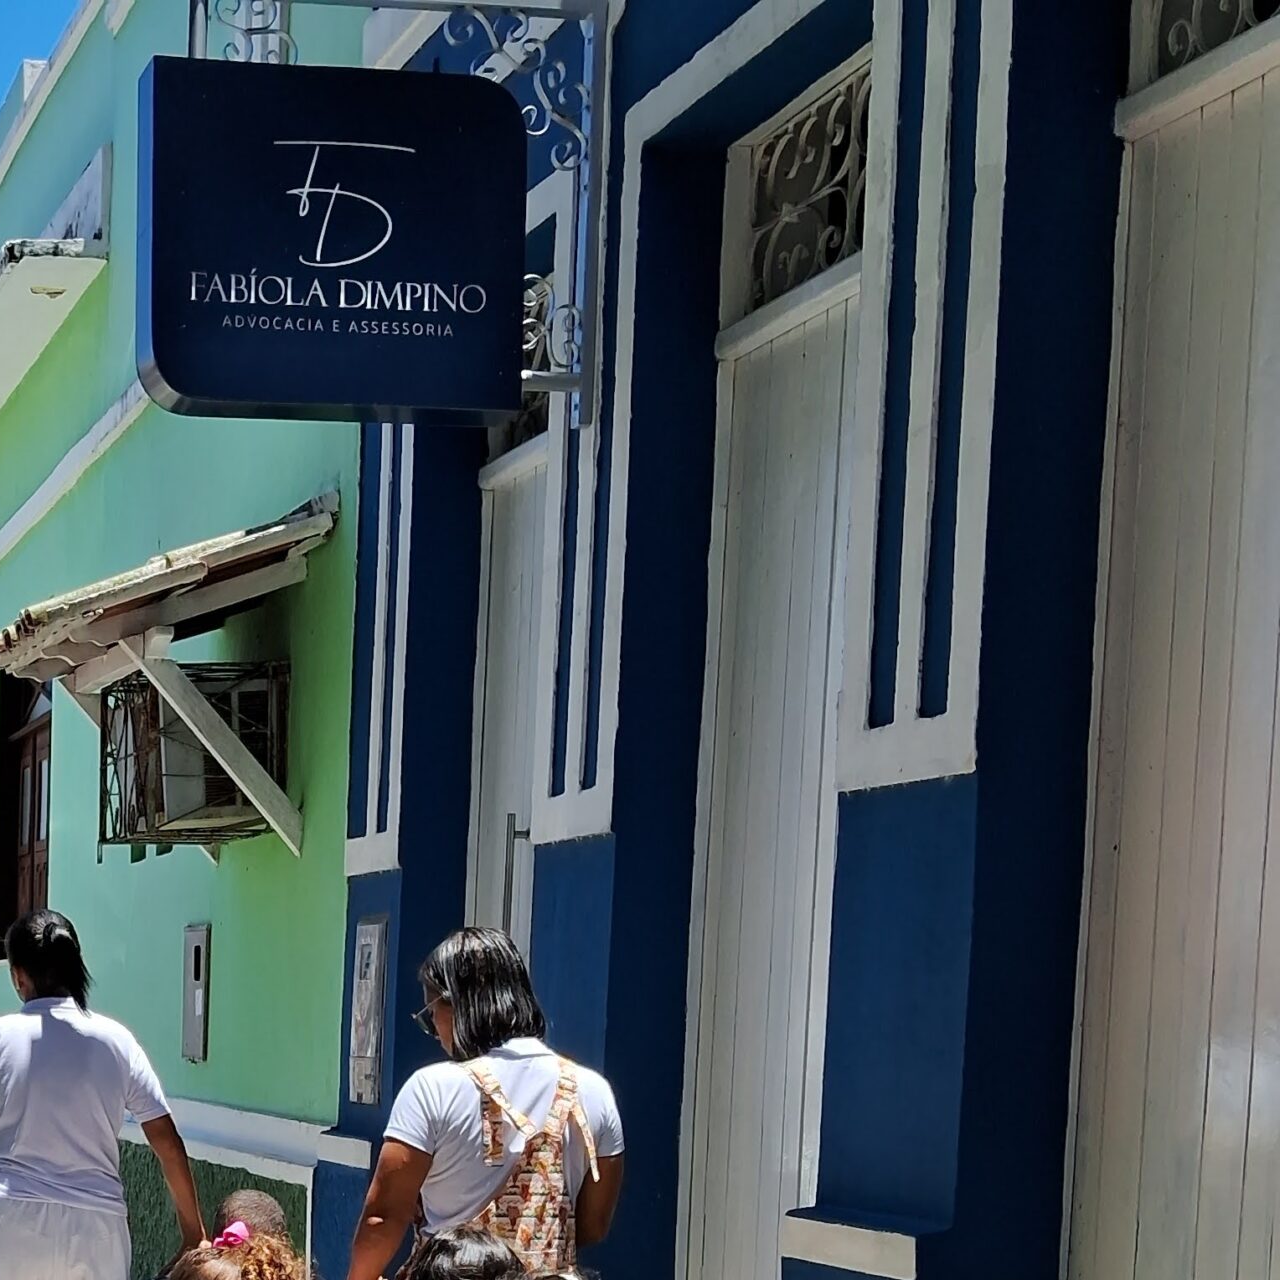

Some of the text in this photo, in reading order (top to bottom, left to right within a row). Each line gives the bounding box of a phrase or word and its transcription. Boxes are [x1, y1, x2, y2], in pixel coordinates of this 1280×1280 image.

[189, 267, 487, 314] FABÍOLA DIMPINO
[222, 314, 454, 337] ADVOCACIA E ASSESSORIA
